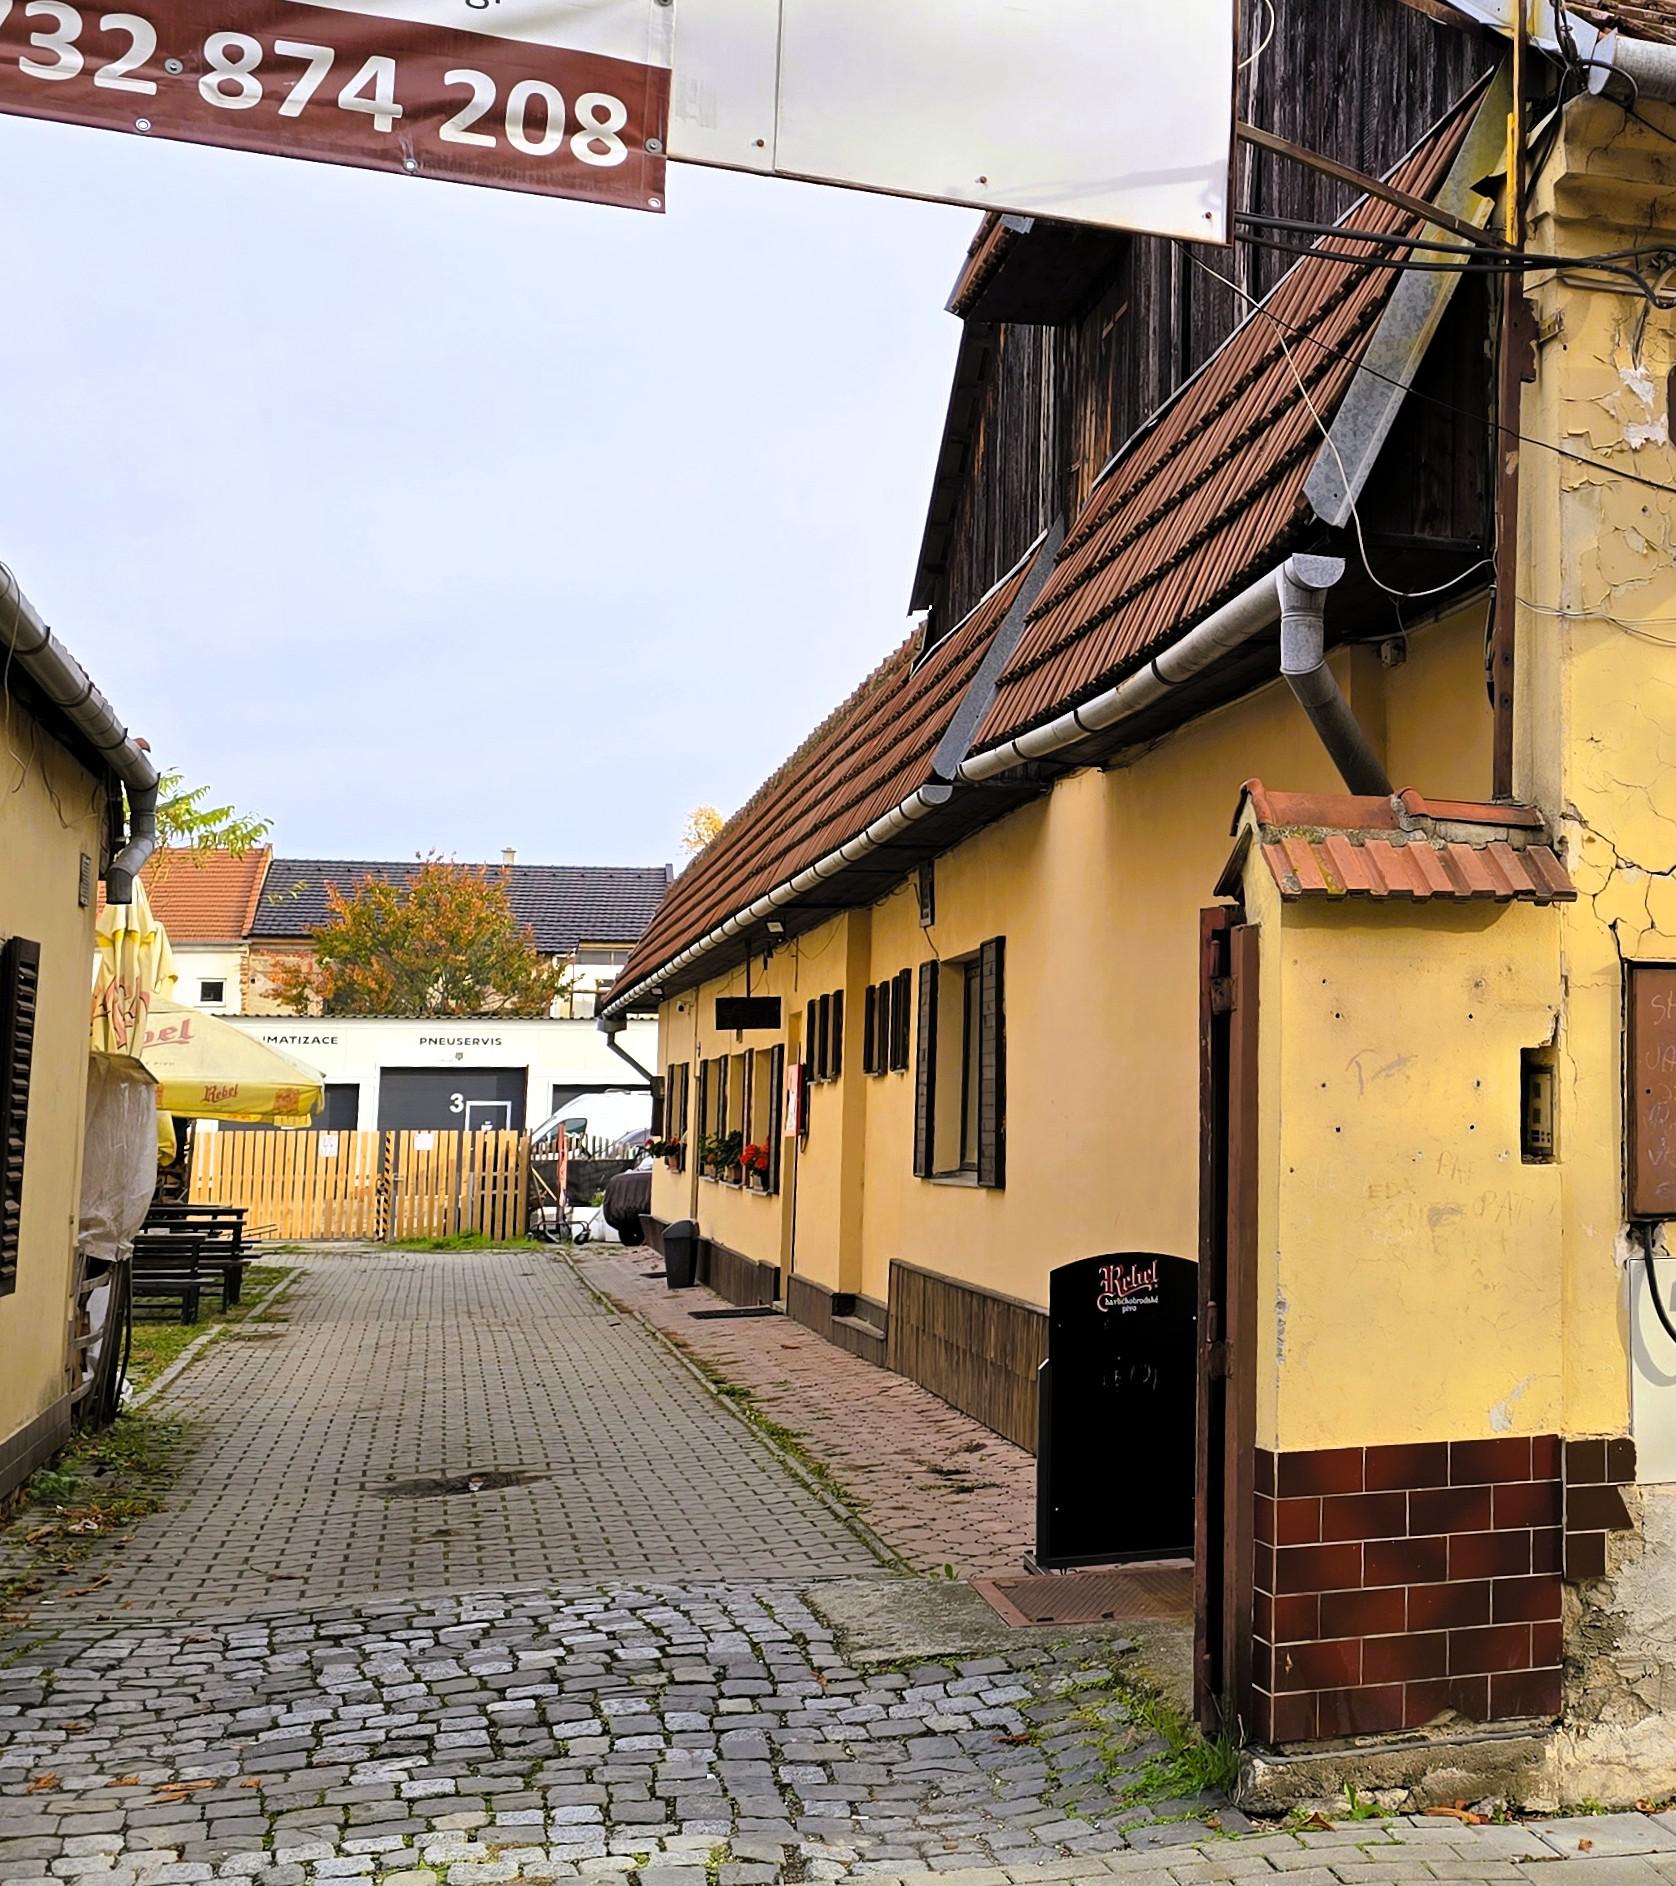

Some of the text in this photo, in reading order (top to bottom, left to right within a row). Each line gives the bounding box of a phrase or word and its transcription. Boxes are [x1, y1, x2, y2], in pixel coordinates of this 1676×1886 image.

[199, 31, 403, 133] 874
[439, 69, 628, 167] 208
[419, 1037, 502, 1047] PNEUSERVIS
[201, 1084, 239, 1104] Rebel
[450, 1093, 464, 1113] 3
